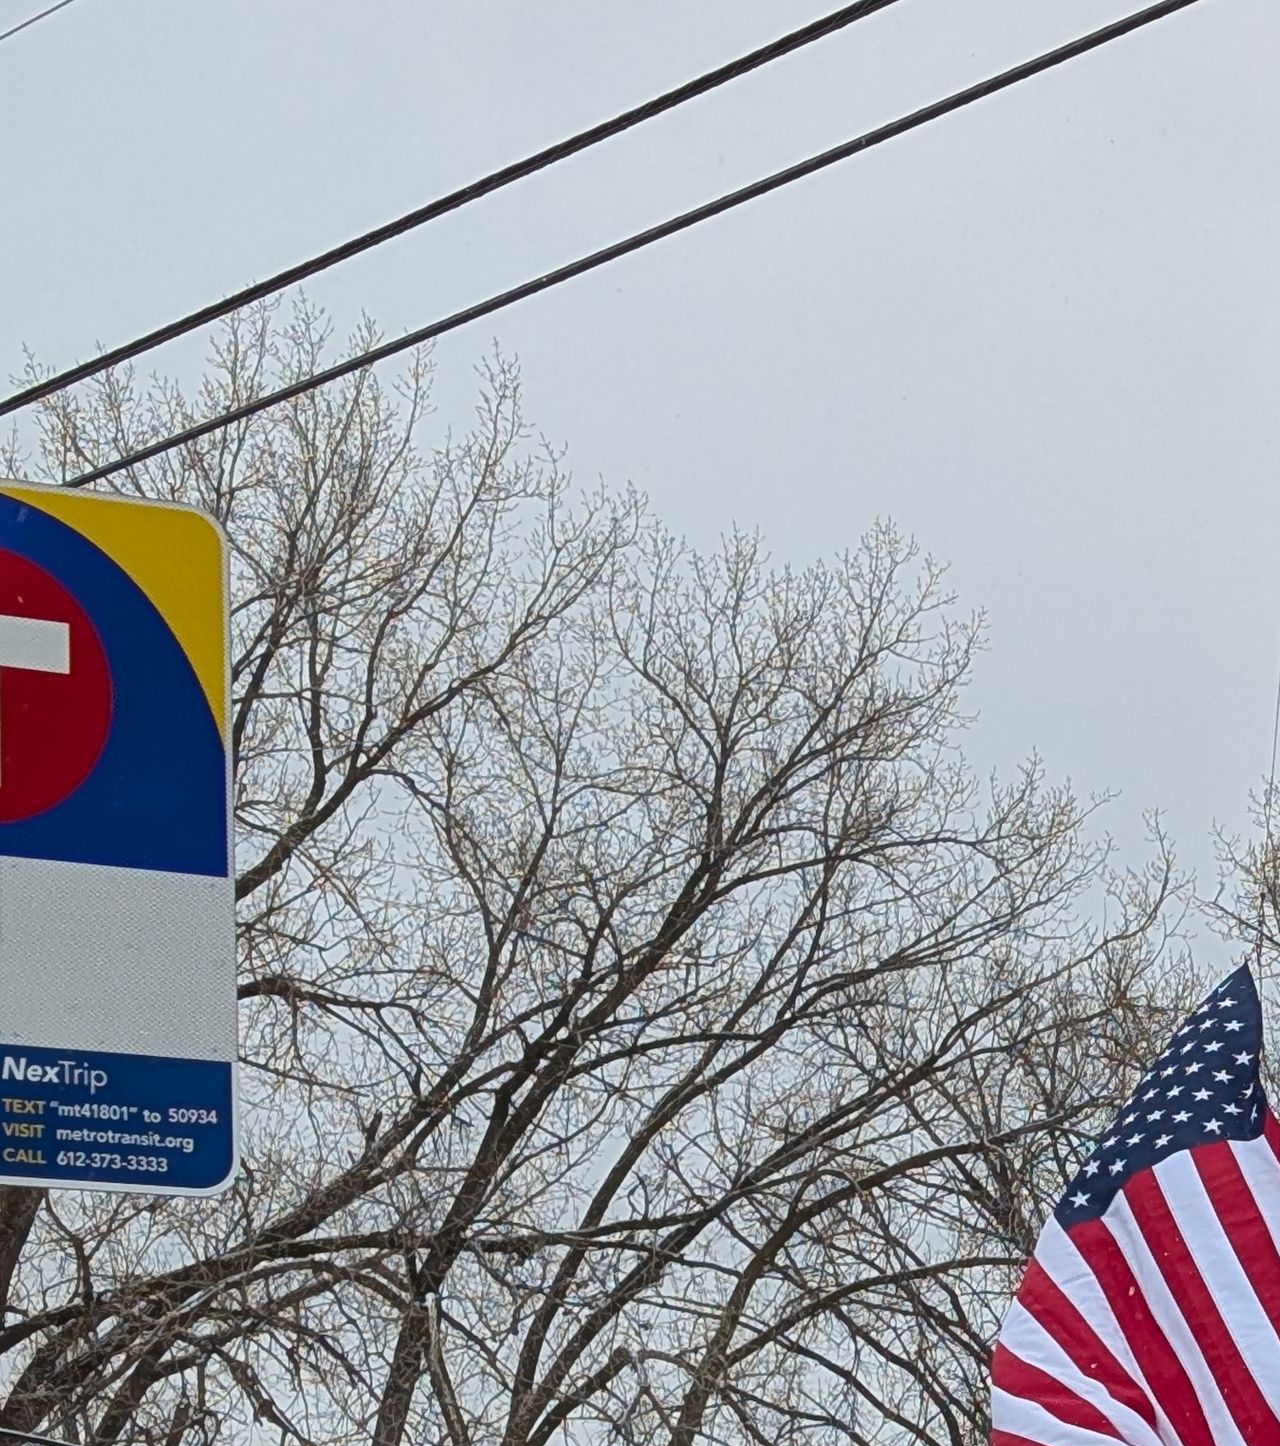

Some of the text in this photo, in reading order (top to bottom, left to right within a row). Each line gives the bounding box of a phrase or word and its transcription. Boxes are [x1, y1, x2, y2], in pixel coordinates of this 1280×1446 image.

[2, 1057, 108, 1095] NexTrip
[3, 1098, 46, 1115] TEXT
[143, 1109, 161, 1123] to
[168, 1108, 218, 1124] 50934
[2, 1122, 194, 1152] VISIT metrotransit.org
[3, 1148, 168, 1172] CALL 612-373-3333
